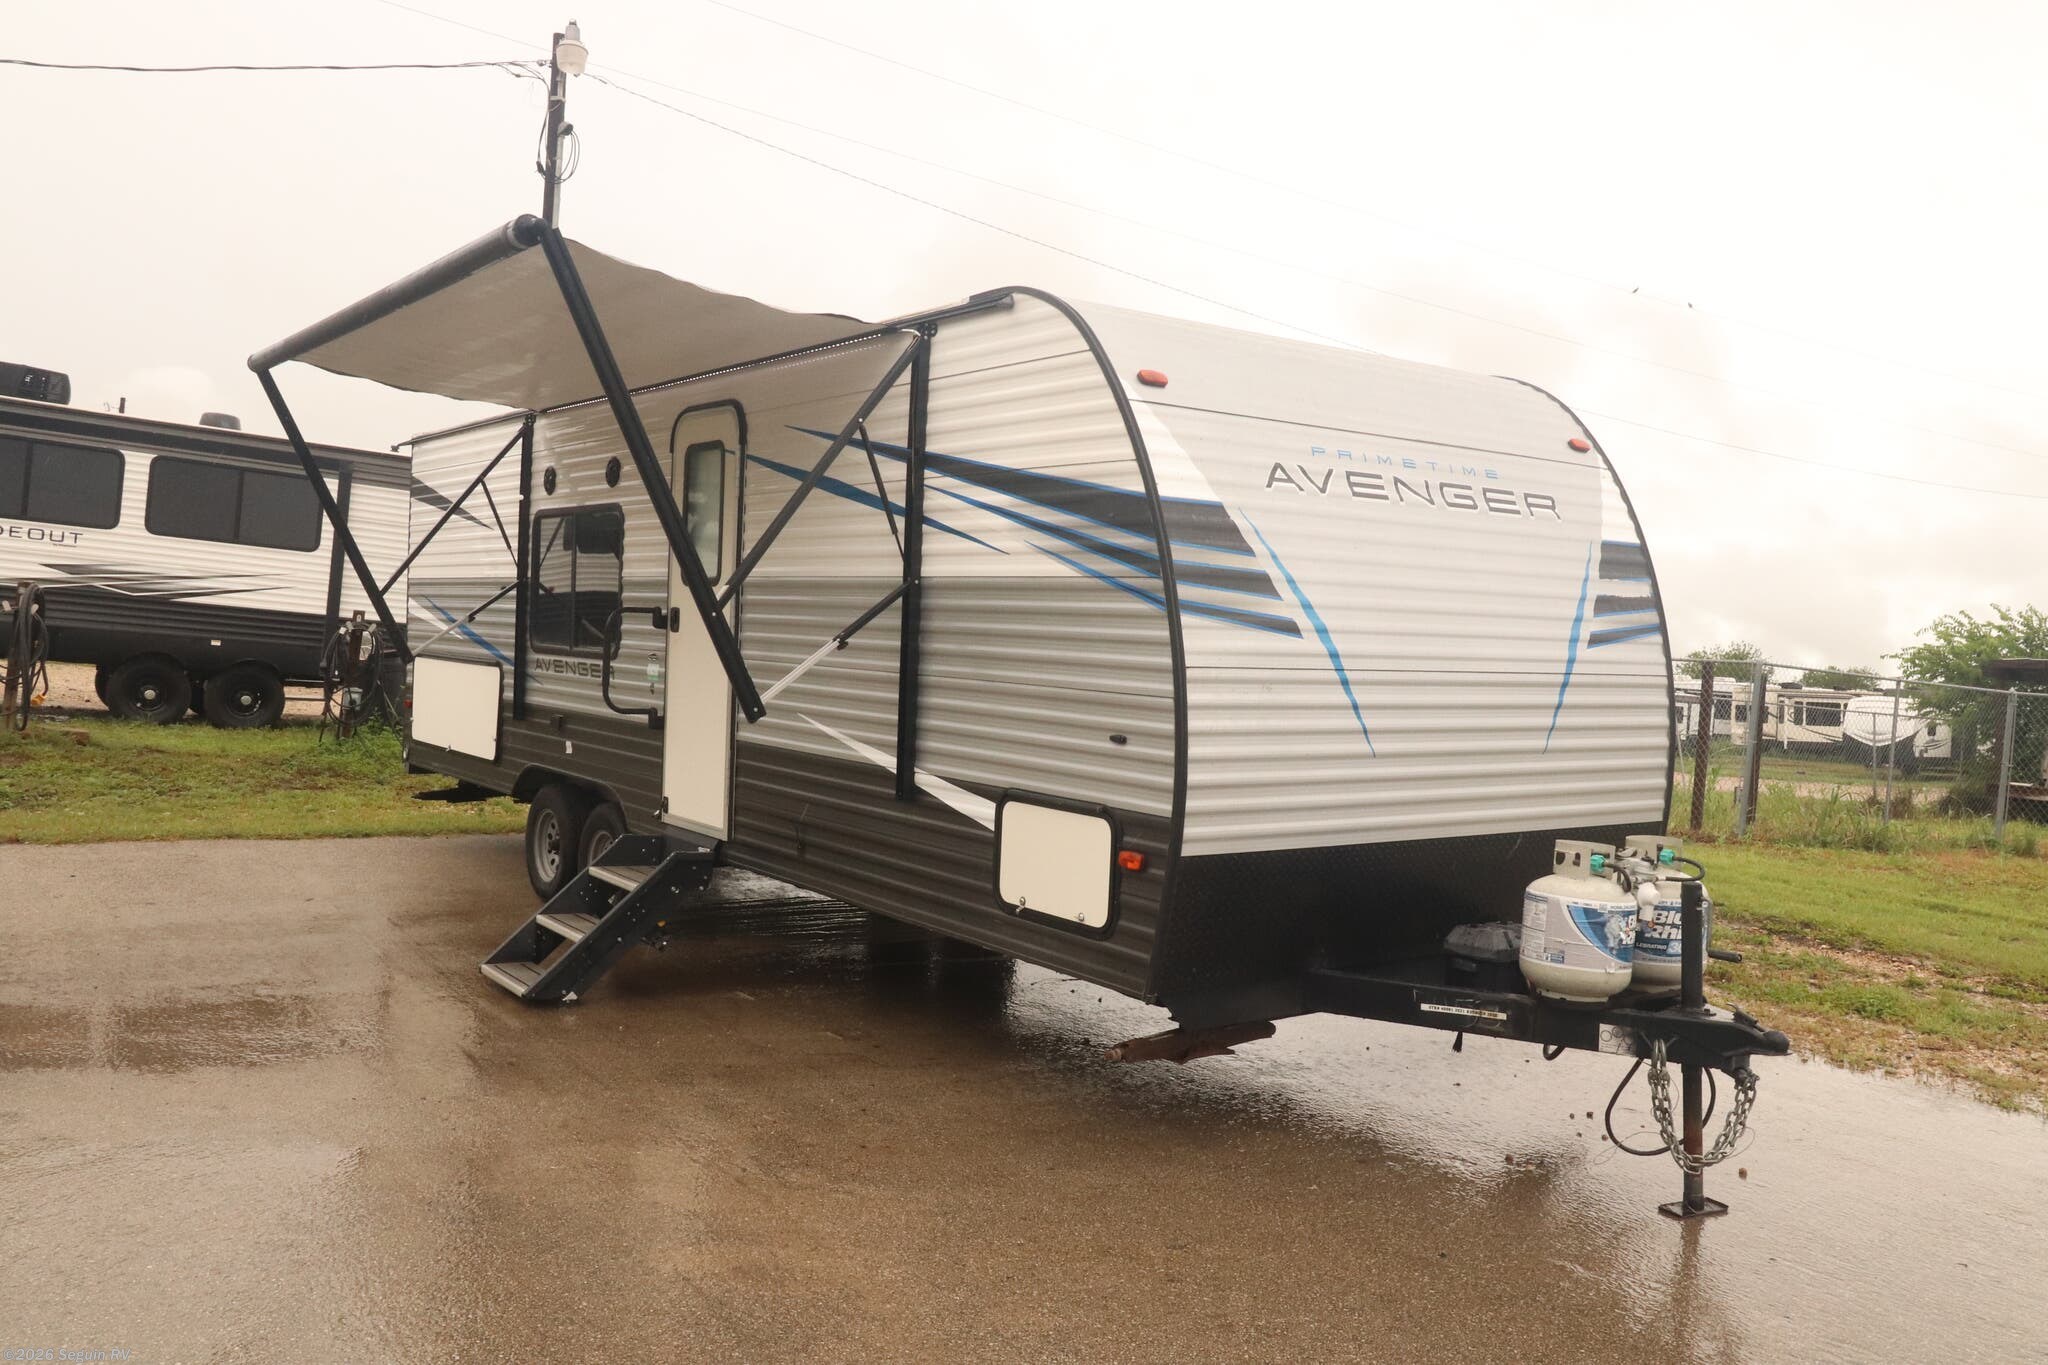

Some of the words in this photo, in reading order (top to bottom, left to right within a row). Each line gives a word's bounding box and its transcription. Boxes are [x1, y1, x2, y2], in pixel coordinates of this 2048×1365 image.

[1265, 462, 1563, 520] AVENGER
[0, 526, 83, 544] EOUT
[1654, 910, 1682, 925] Blu
[1645, 925, 1682, 940] Rhi
